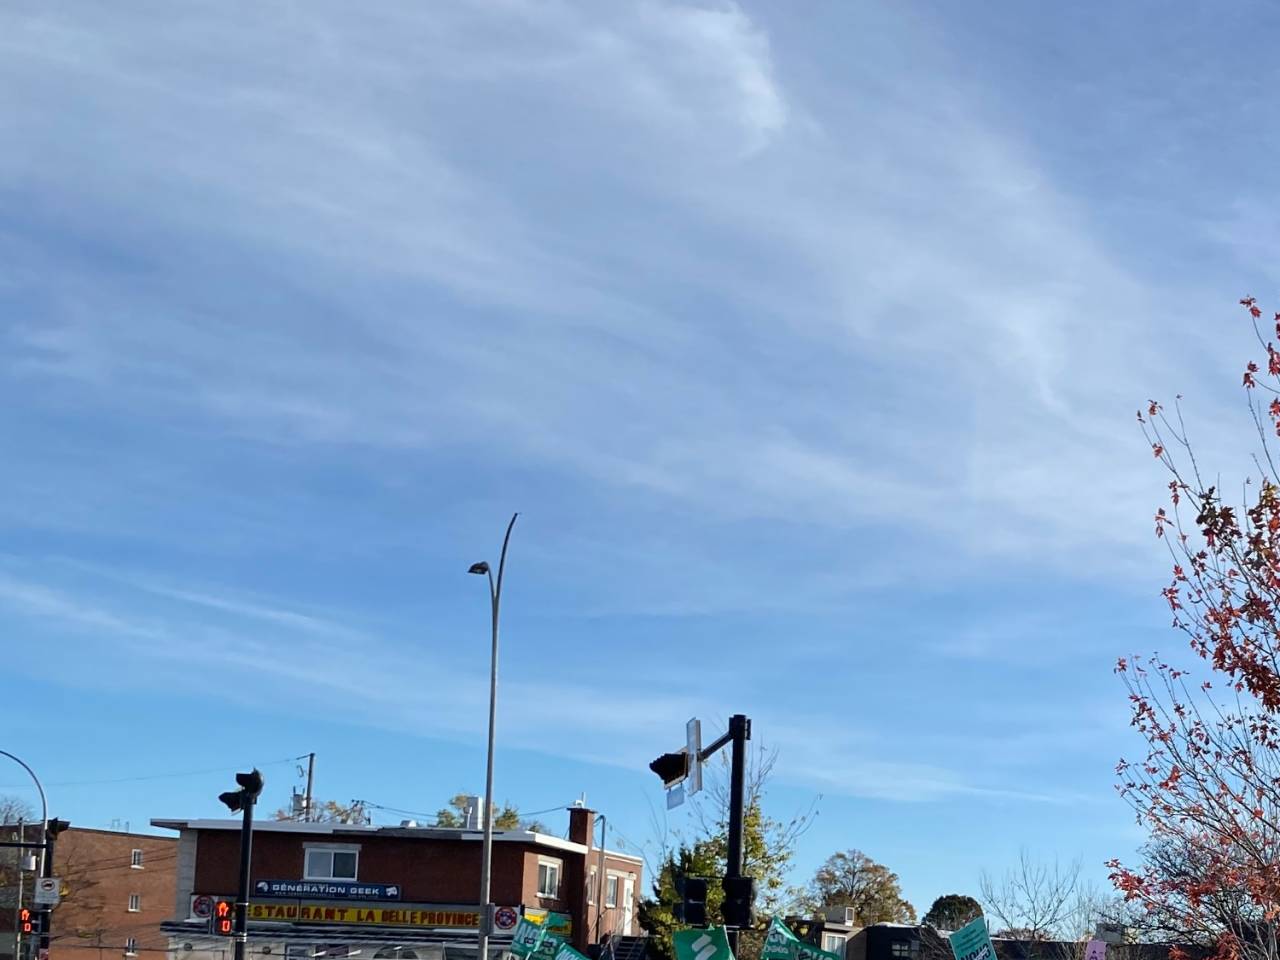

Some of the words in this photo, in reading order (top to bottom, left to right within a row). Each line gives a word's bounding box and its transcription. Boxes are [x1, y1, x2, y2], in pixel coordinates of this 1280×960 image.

[350, 887, 379, 895] GEEK
[357, 909, 375, 922] LA
[421, 911, 479, 925] PROVINCE
